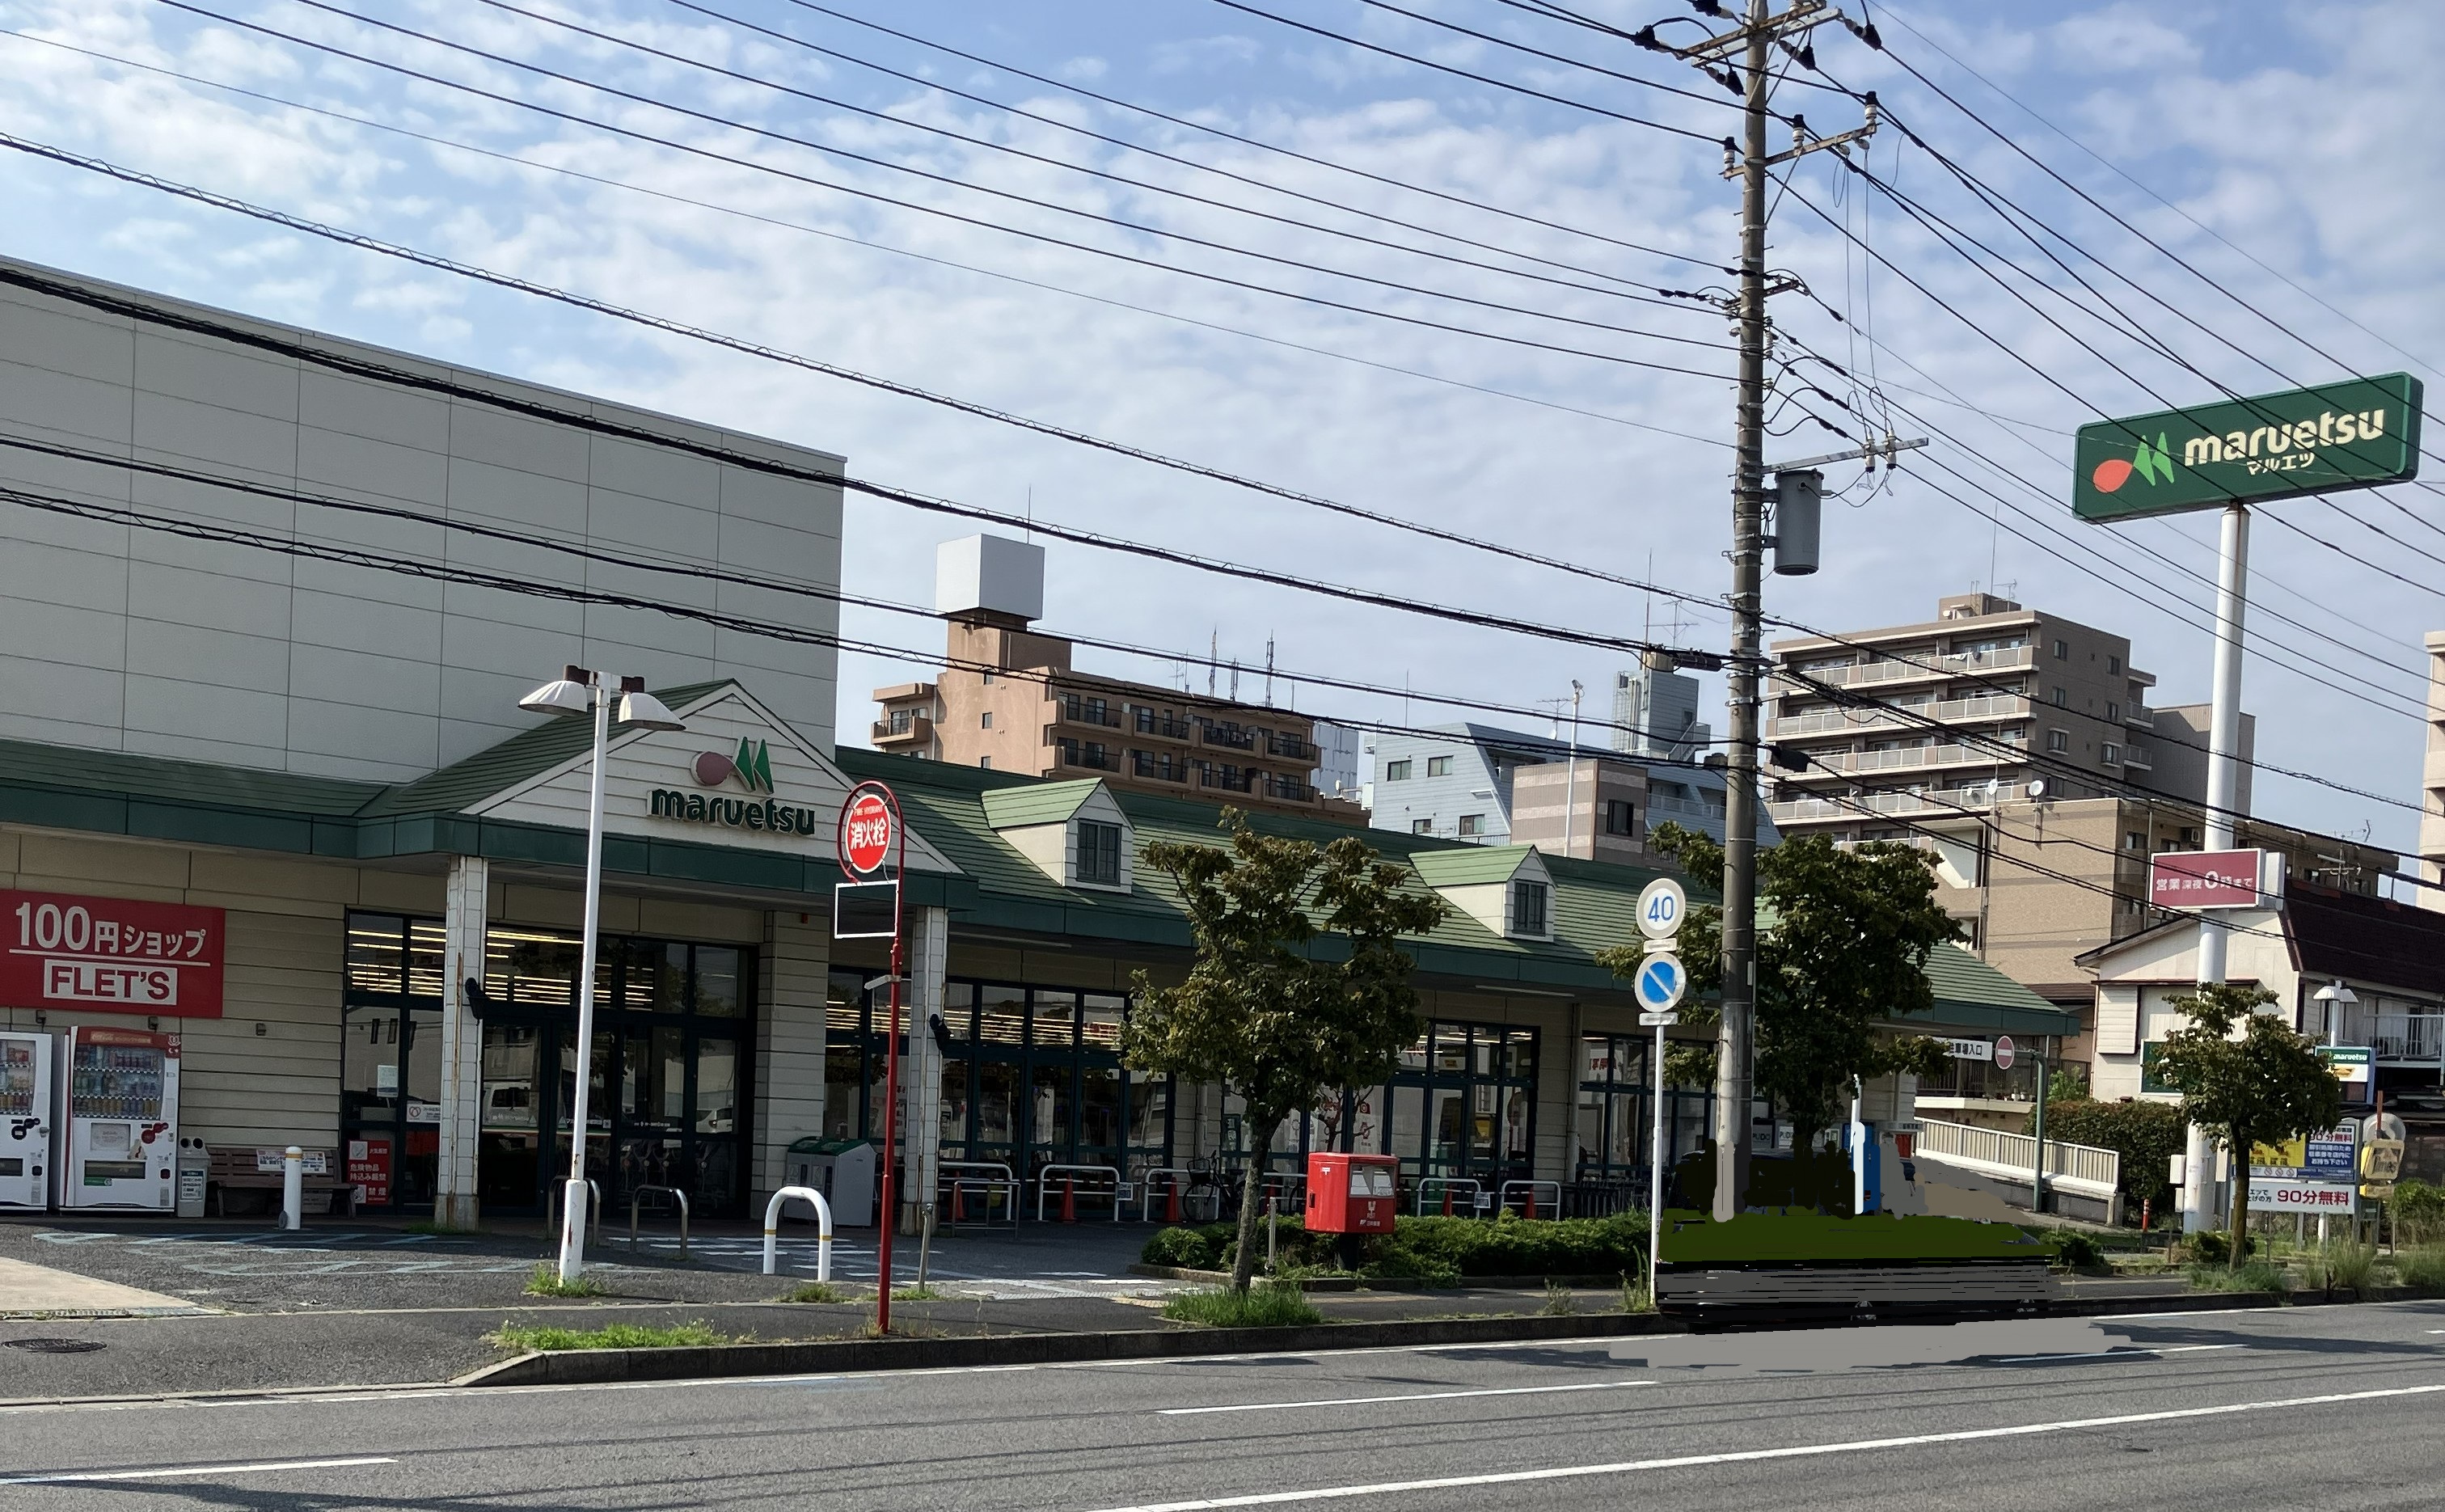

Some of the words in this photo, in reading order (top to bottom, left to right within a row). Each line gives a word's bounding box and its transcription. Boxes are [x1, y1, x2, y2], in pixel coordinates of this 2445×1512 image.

[2185, 409, 2385, 467] maruetsu
[2245, 452, 2315, 475] マルエツ
[649, 788, 816, 835] maruetsu
[850, 817, 887, 850] 消火栓
[1648, 896, 1674, 923] 40
[15, 902, 207, 958] 100円ショップ
[51, 965, 171, 1000] FLET'S
[1780, 1131, 1793, 1139] PUD
[2277, 1190, 2349, 1206] 90分無料
